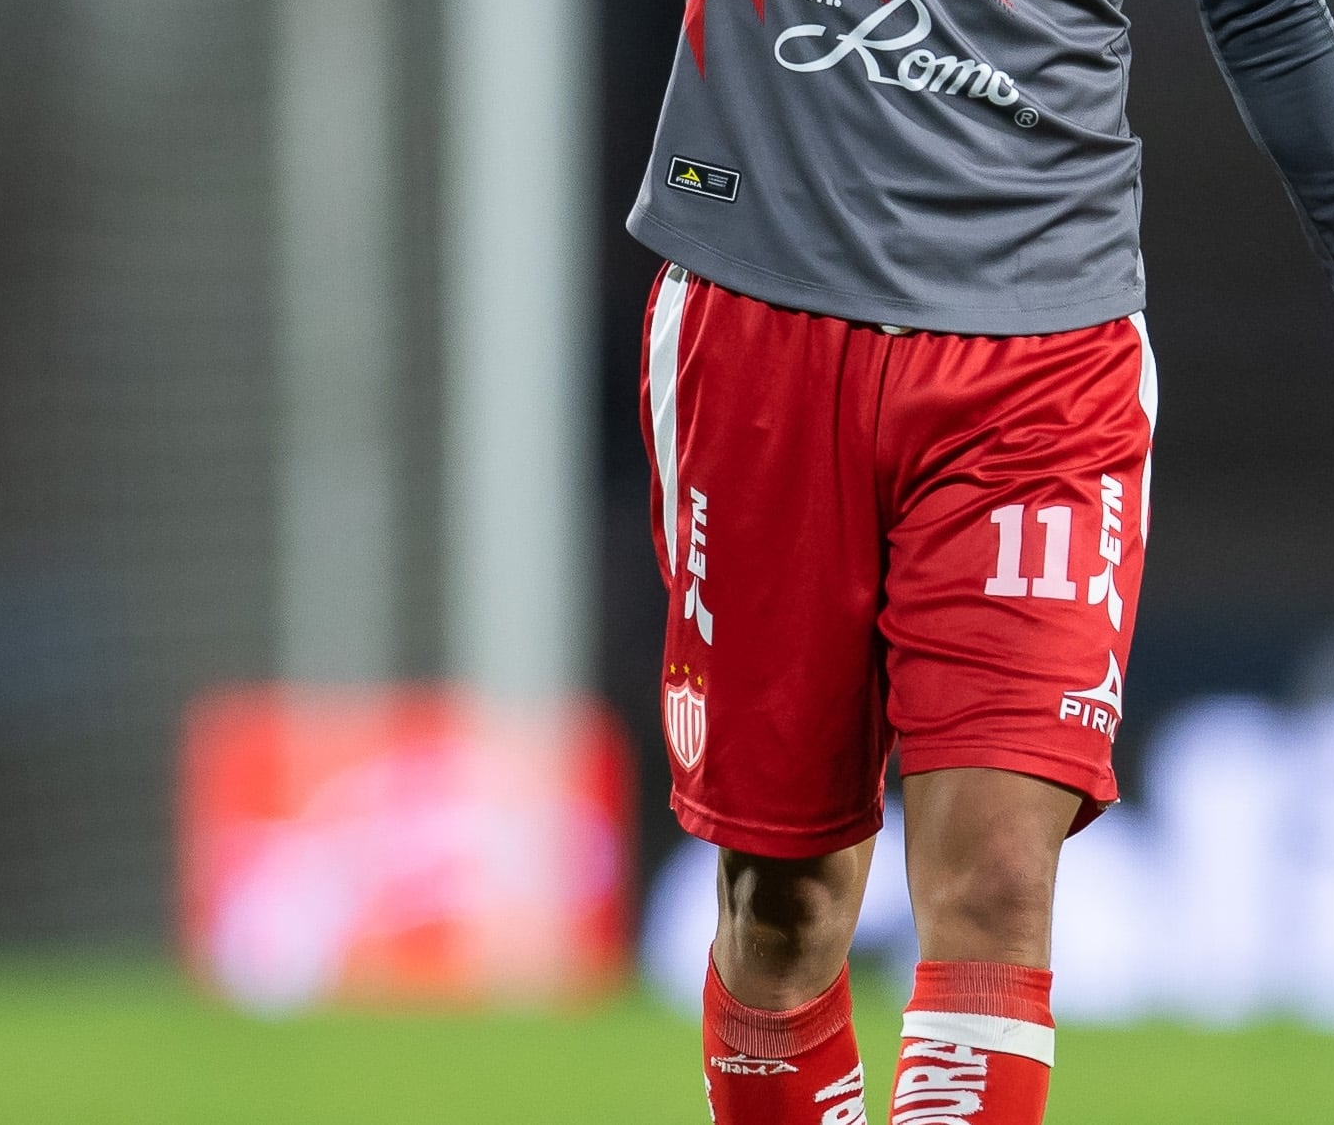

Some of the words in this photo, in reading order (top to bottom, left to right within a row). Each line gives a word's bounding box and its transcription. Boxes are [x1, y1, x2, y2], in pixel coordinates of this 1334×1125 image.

[687, 487, 708, 580] ETN
[984, 504, 1077, 601] 11
[1098, 473, 1123, 567] ETN
[1060, 697, 1117, 744] PIRM
